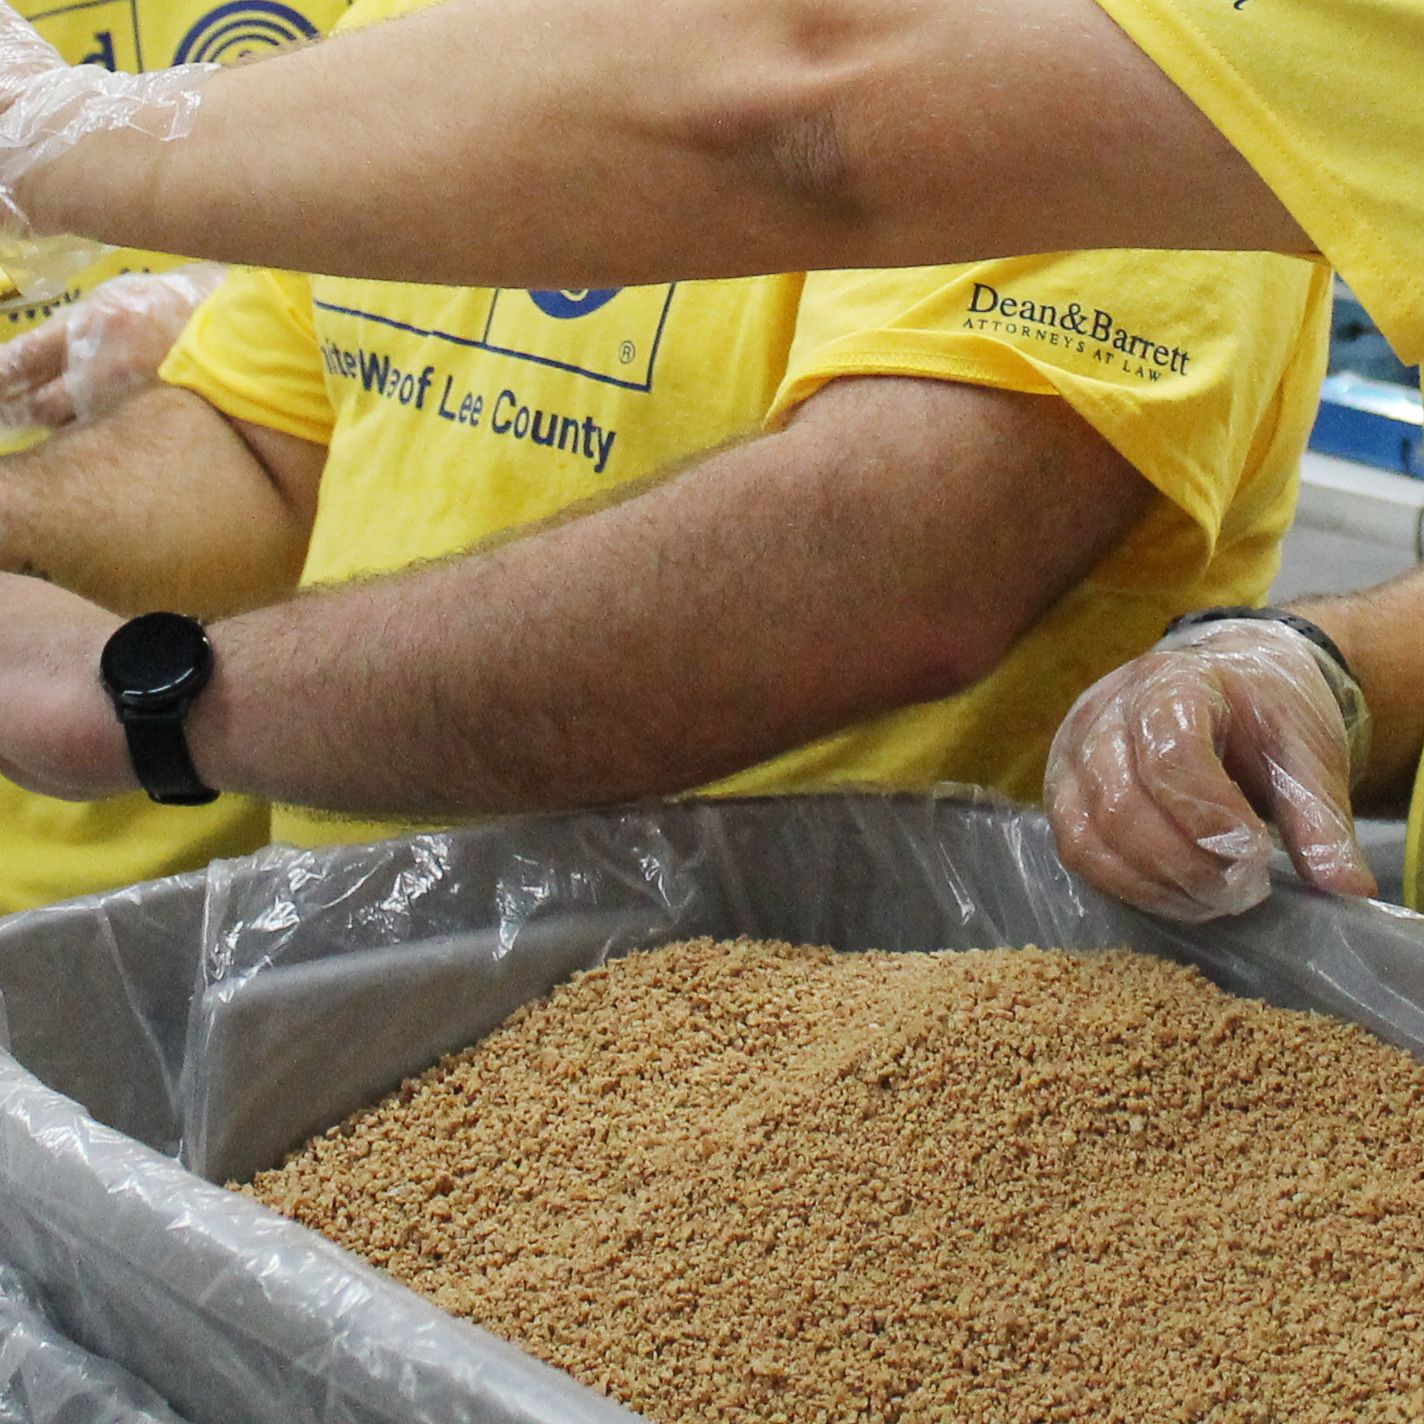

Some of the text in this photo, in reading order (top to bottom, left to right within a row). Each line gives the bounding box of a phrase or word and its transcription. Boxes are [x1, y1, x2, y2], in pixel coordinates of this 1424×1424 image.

[962, 317, 1162, 383] ATTORNEYS AT LAW
[967, 282, 1191, 377] Dean&Barrett
[439, 374, 483, 427] Lee
[492, 388, 616, 474] County
